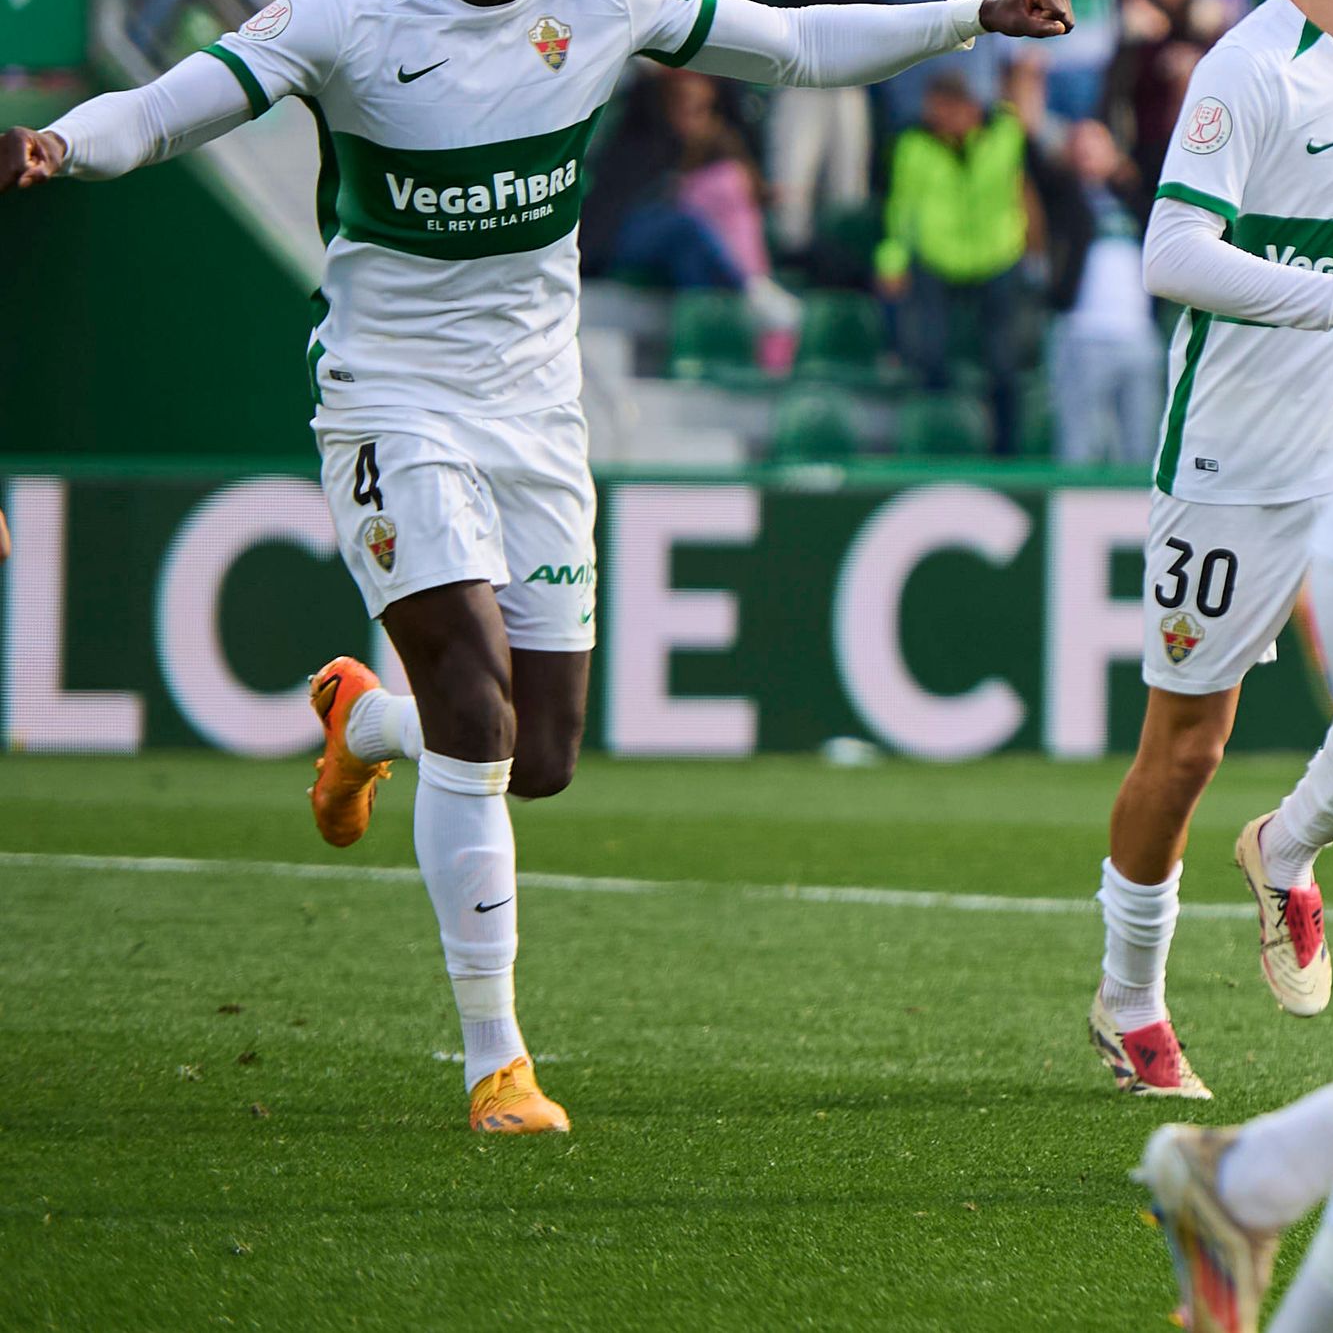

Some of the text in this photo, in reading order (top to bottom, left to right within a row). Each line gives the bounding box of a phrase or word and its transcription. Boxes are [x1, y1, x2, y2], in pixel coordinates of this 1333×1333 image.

[427, 204, 555, 231] EL REY DE LA FIBRA
[353, 441, 384, 512] 4
[1155, 536, 1239, 618] 30
[5, 474, 1149, 763] LCE CF
